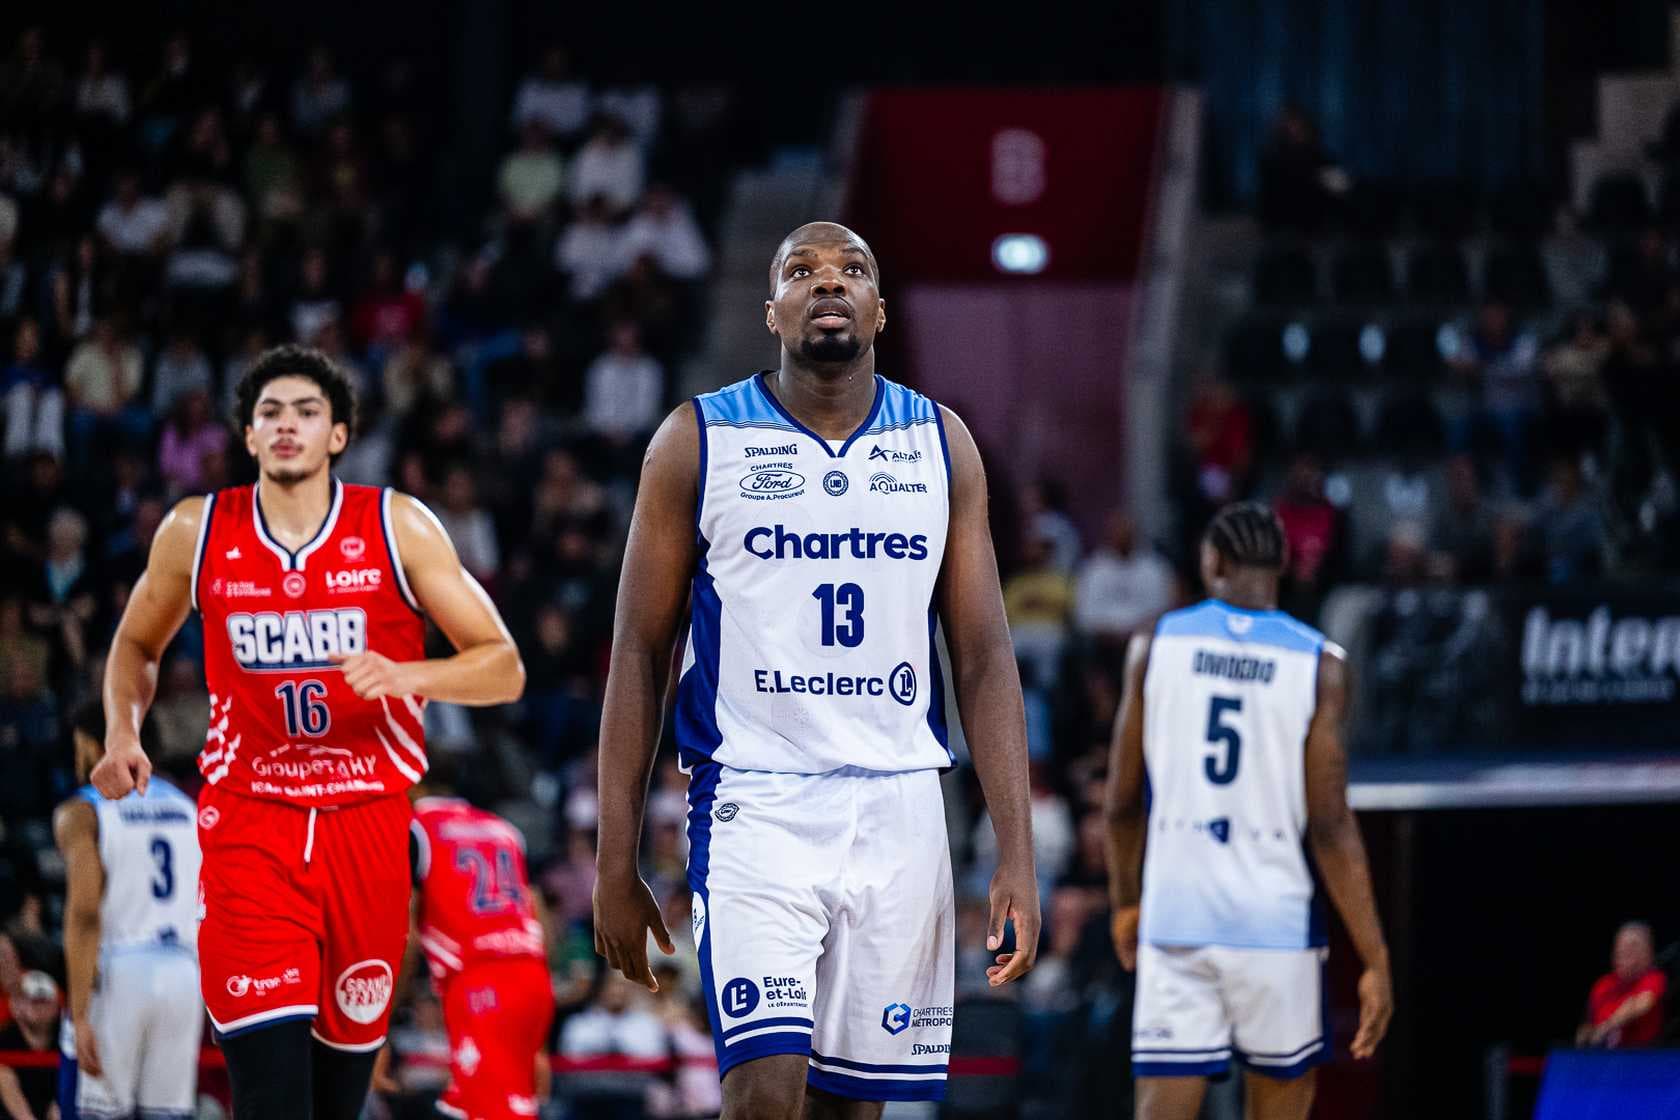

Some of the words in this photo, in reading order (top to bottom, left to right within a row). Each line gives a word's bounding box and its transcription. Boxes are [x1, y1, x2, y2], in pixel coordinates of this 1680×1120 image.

[744, 444, 798, 458] SPALDING
[750, 462, 793, 471] CHARTRES
[740, 491, 765, 501] Groupe
[752, 473, 792, 490] Ford
[743, 524, 928, 560] Chartres
[812, 582, 865, 648] 13
[228, 608, 367, 668] SCABB
[754, 669, 884, 697] E.Leclerc
[275, 680, 331, 737] 16
[1204, 695, 1243, 786] 5
[150, 838, 174, 900] 3
[763, 976, 800, 988] Eure-
